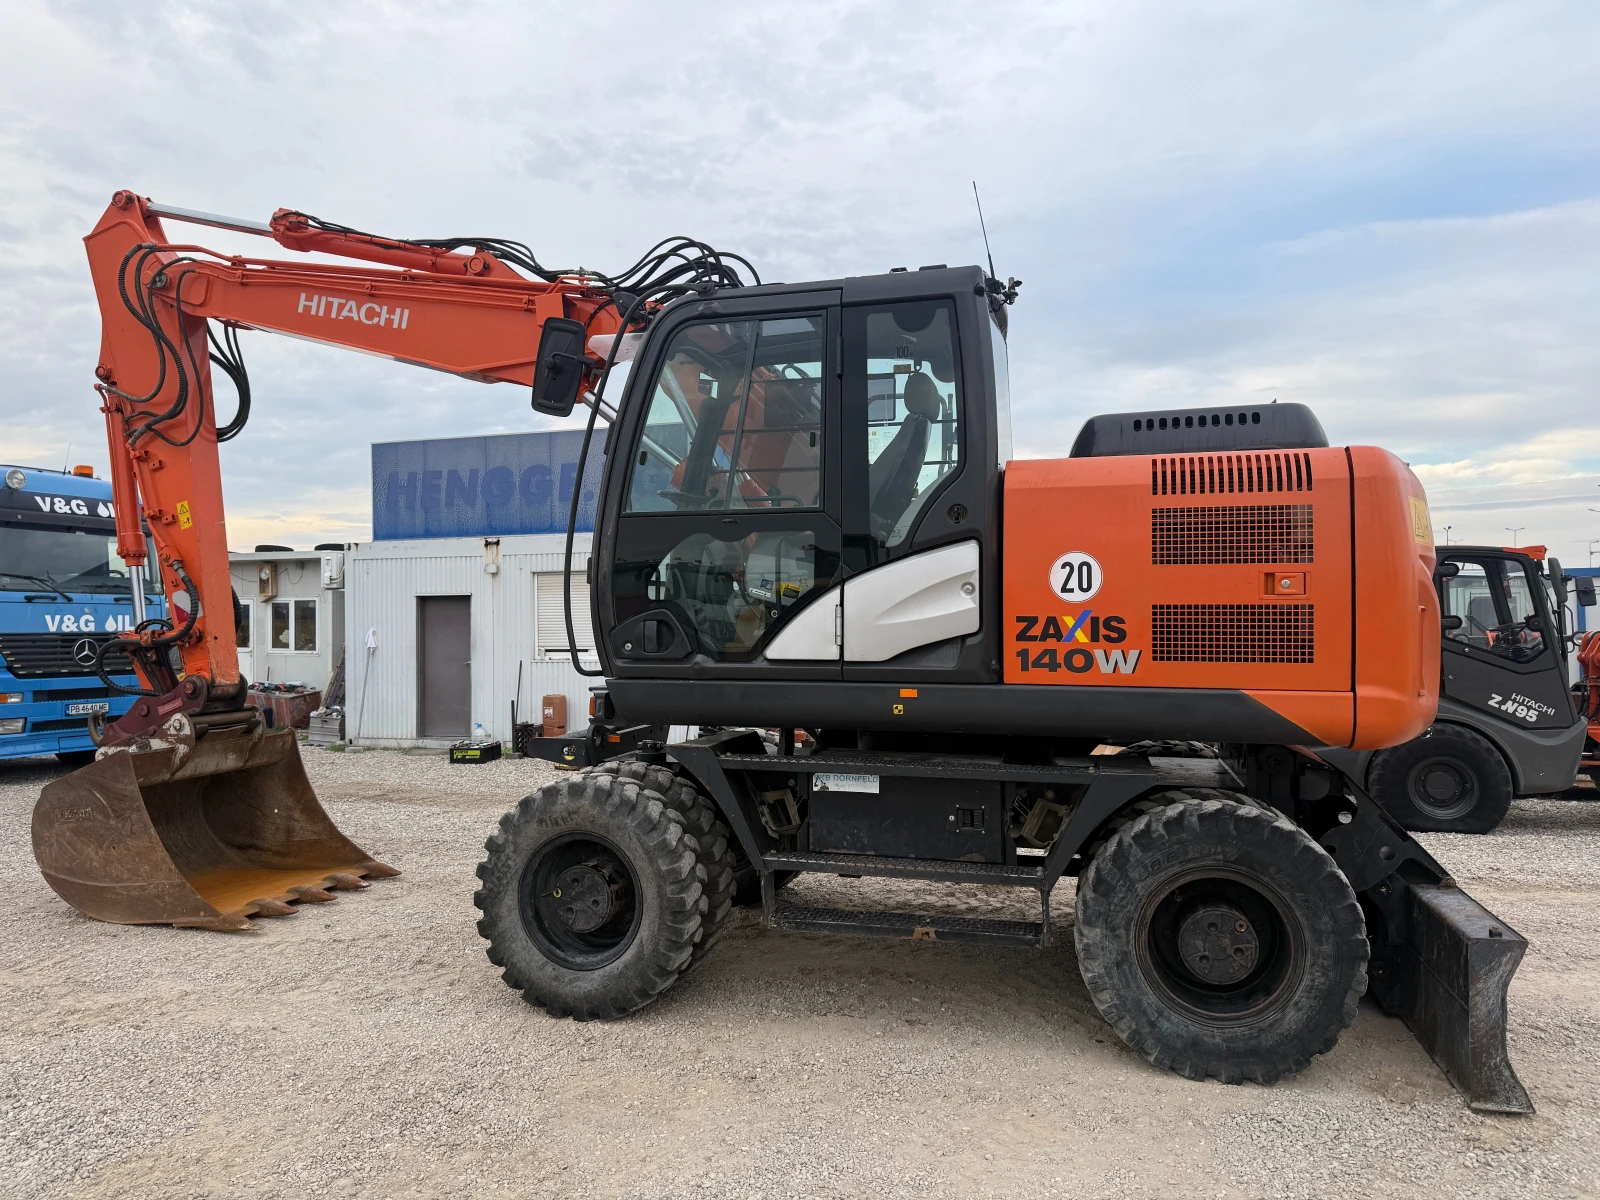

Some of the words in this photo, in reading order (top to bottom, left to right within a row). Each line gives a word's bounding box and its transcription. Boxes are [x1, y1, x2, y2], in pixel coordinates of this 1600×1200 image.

[298, 292, 409, 329] HITACHI
[896, 346, 909, 358] 100
[34, 495, 89, 515] V&G
[1060, 561, 1093, 593] 20
[44, 614, 95, 632] V&G
[1015, 609, 1128, 643] ZAXIS
[1015, 648, 1142, 674] 140W
[1511, 692, 1555, 715] HITACHI
[833, 774, 879, 783] DORNFELD
